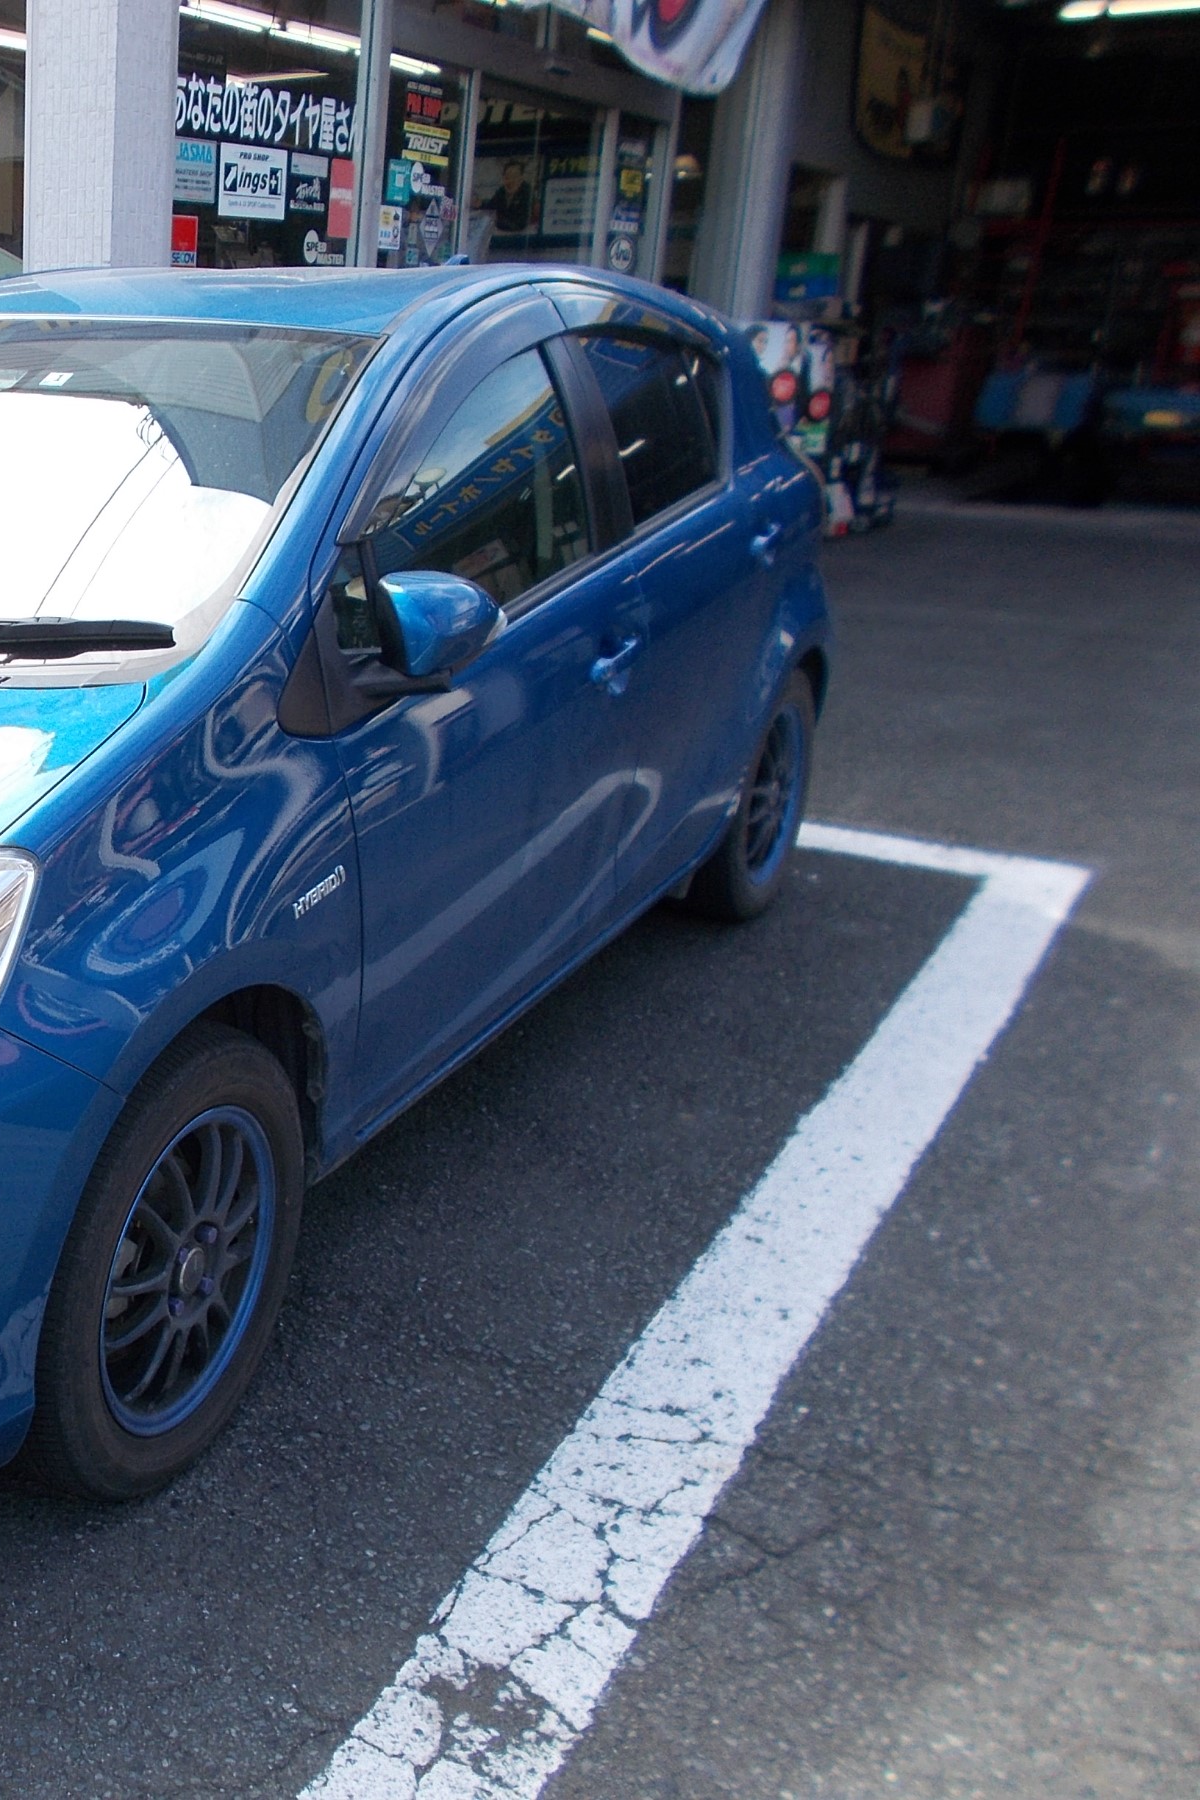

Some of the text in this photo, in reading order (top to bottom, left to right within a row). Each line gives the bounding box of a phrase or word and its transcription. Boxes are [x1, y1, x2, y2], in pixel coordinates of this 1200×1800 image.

[405, 132, 449, 155] TRUST
[176, 142, 213, 164] JASMA
[240, 151, 270, 162] PRO SHOP
[421, 184, 445, 196] MASTER
[306, 241, 327, 253] SPEED
[171, 252, 195, 265] SECOM
[317, 253, 344, 265] MASTER
[292, 865, 346, 920] HYBRID
